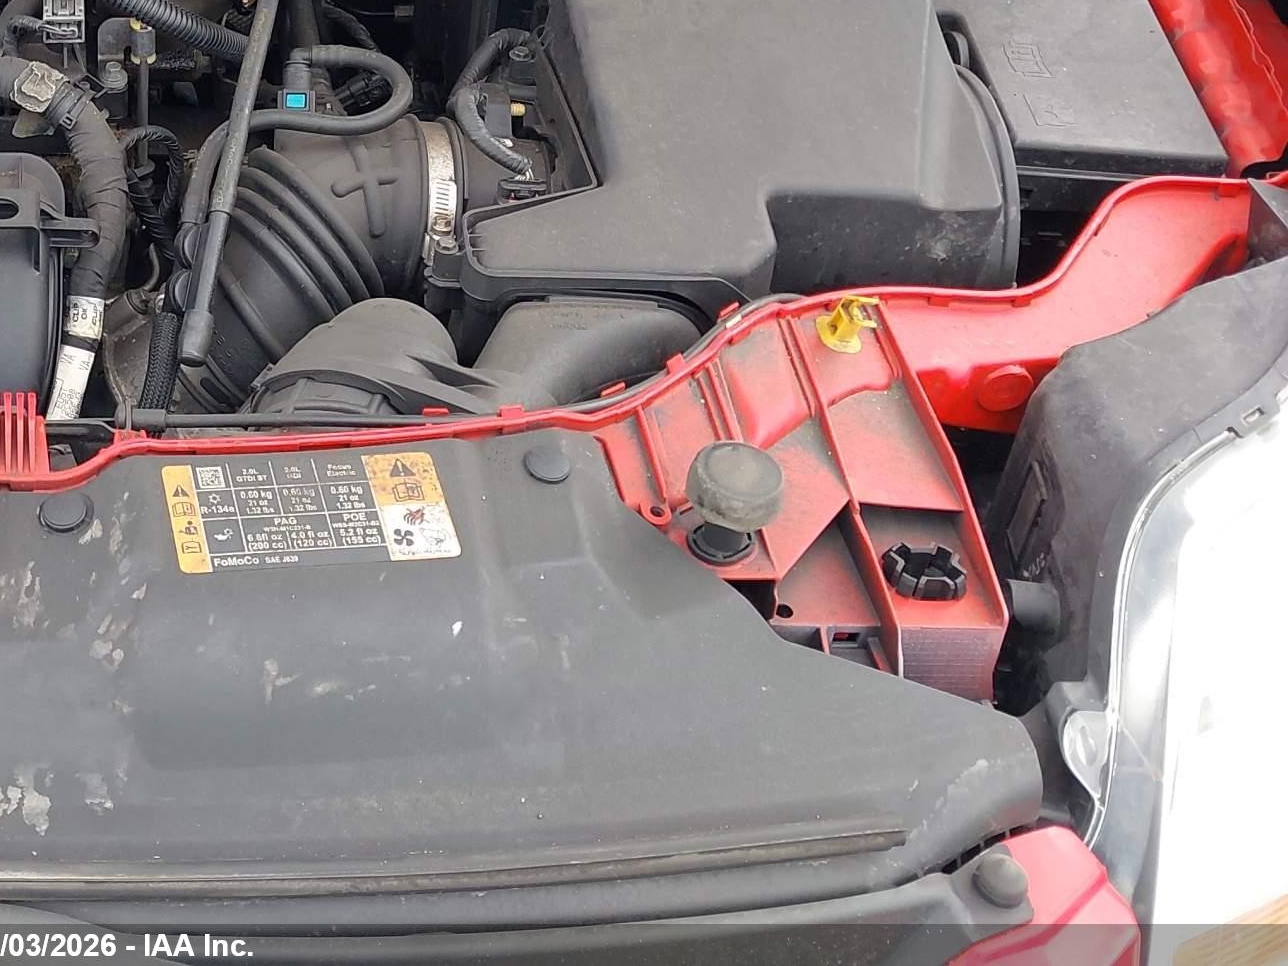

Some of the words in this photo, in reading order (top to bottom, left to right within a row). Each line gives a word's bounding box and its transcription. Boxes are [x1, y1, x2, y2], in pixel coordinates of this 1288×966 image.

[261, 490, 273, 500] kg
[303, 488, 316, 497] kg
[351, 485, 363, 496] kg
[201, 505, 235, 515] R-134a
[273, 516, 298, 526] PAG
[343, 512, 368, 522] POE
[339, 528, 354, 537] 5.2
[366, 527, 378, 535] oz
[294, 539, 314, 549] (120
[317, 538, 333, 547] cc)
[365, 535, 382, 544] cc)
[248, 542, 270, 552] (200
[271, 541, 288, 550] cc)
[213, 555, 260, 567] FoMoCo
[265, 556, 281, 564] SAE
